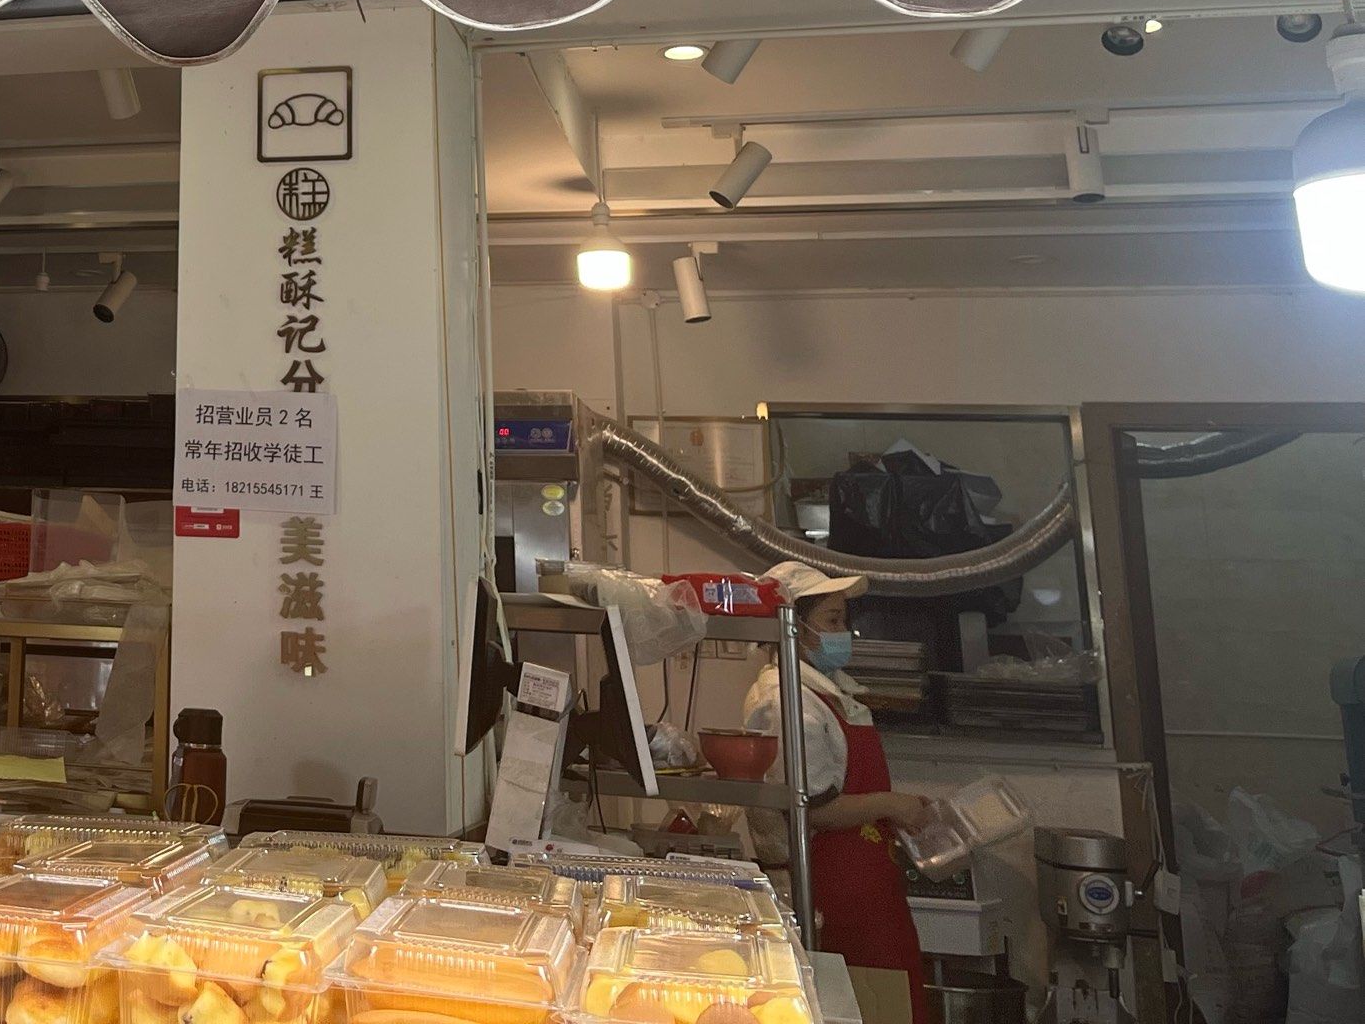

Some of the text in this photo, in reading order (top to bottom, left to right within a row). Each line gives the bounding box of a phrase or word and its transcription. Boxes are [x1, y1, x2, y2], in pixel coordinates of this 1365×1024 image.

[184, 439, 324, 464] 常年招收学徒工
